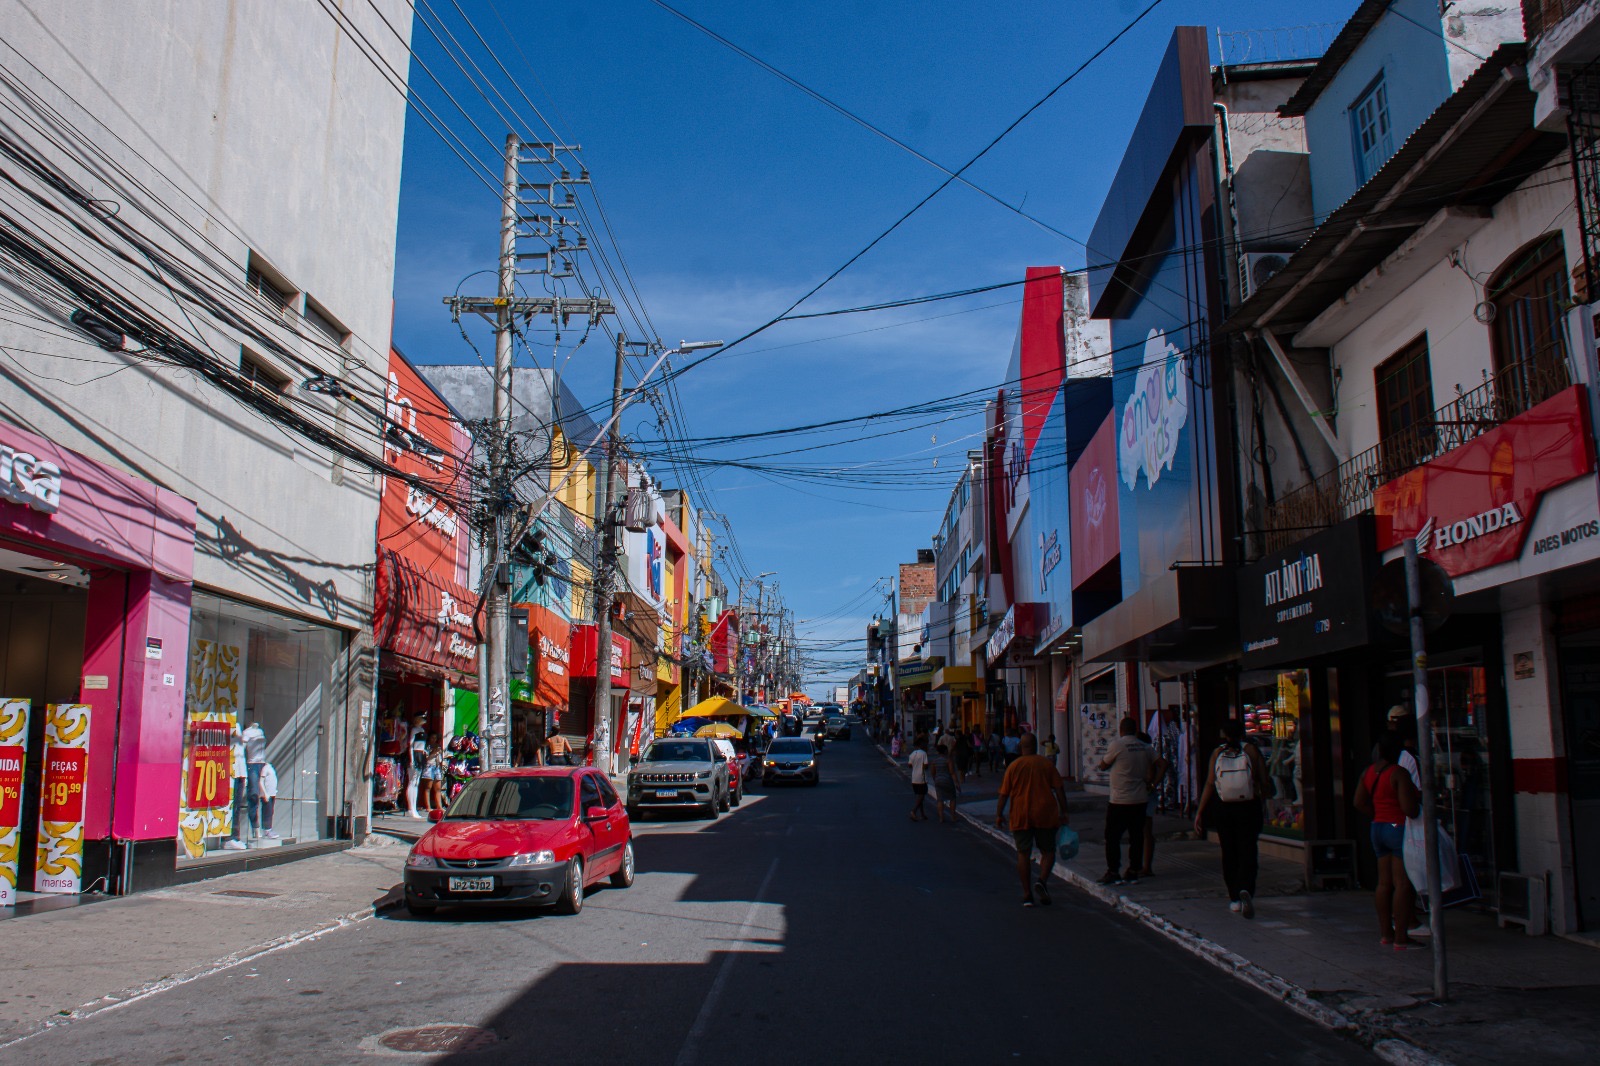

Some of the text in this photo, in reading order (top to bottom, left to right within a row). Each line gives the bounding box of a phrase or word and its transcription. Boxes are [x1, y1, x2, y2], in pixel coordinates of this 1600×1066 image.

[1434, 501, 1525, 551] HONDA
[1533, 519, 1599, 556] ARES MOTOS
[1277, 602, 1313, 623] SUPLEMENTOS
[1082, 705, 1089, 714] 4
[1089, 713, 1096, 722] 4
[1100, 720, 1107, 729] 9
[195, 729, 227, 749] LIQUIDA
[51, 761, 78, 774] PEÇAS
[195, 760, 226, 801] 70%
[49, 782, 81, 806] 19,99
[41, 878, 73, 890] marisa
